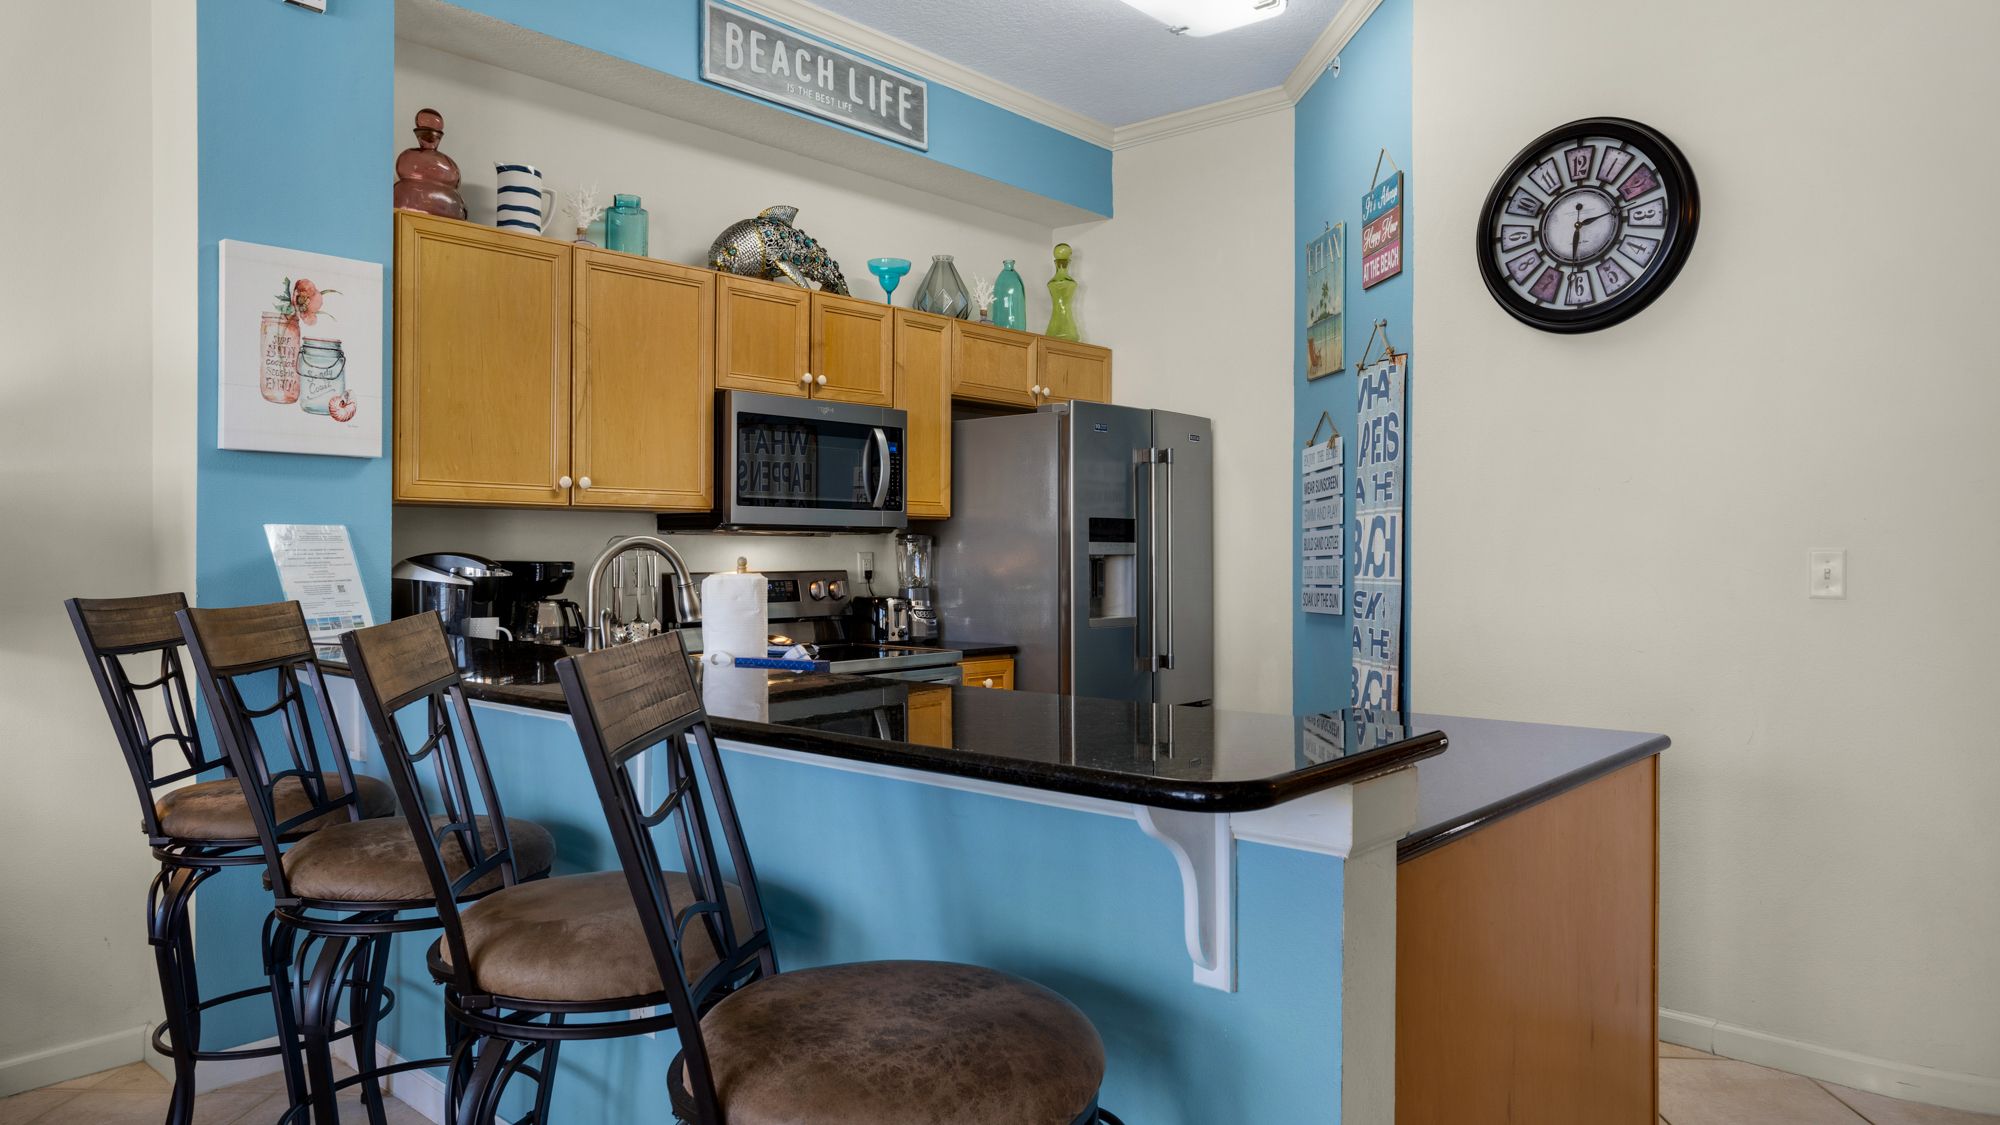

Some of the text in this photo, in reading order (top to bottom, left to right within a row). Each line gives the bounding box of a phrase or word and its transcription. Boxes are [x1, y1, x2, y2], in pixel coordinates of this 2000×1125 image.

[726, 22, 912, 130] BEACH LIFE
[787, 83, 852, 113] IS THE BEST LIFE
[1572, 155, 1587, 177] 12
[1606, 158, 1618, 177] 1
[1541, 170, 1556, 190] 11
[1624, 176, 1642, 195] 2
[1517, 197, 1537, 213] 10
[1633, 209, 1656, 221] 3
[1508, 231, 1528, 242] 9
[1626, 241, 1648, 255] 4
[1363, 246, 1399, 282] AT THE BEACH
[1518, 258, 1536, 272] 8
[1603, 264, 1619, 284] 5
[1575, 276, 1585, 296] 6
[1315, 474, 1339, 493] SUNSCREEN
[1320, 592, 1329, 607] THE
[1329, 592, 1339, 608] SUN
